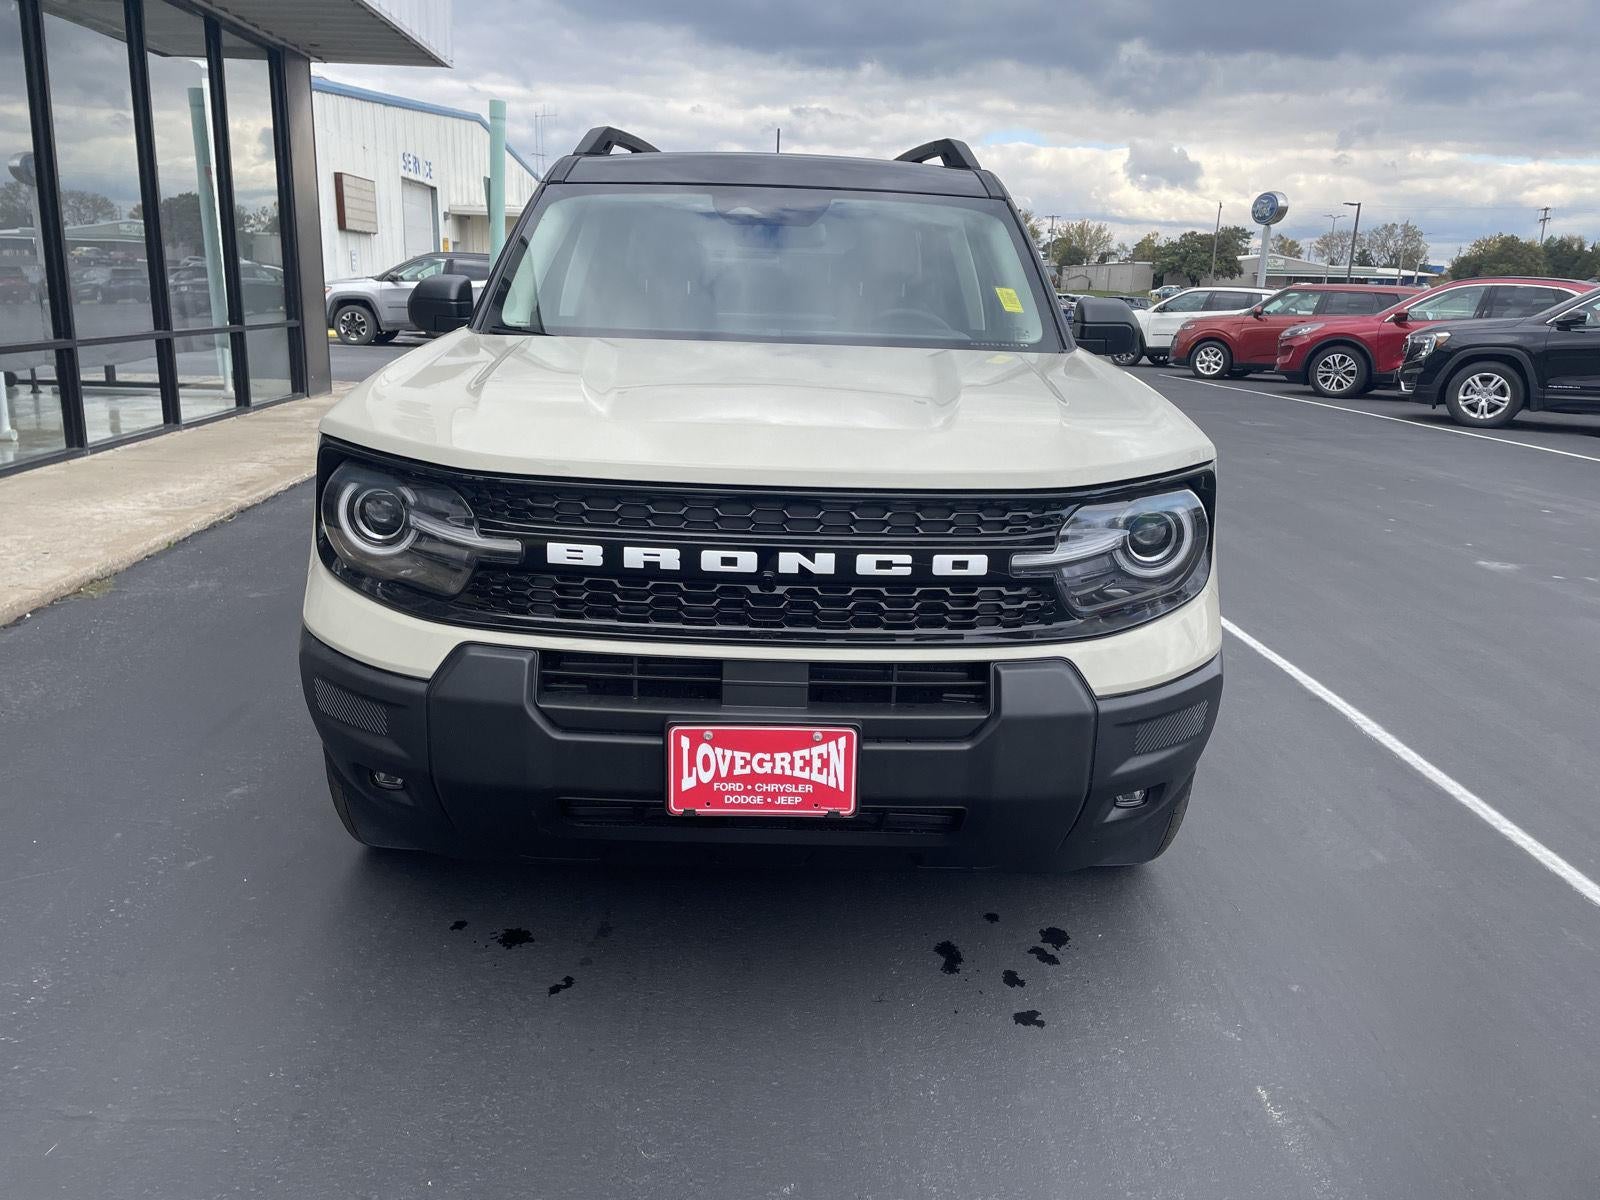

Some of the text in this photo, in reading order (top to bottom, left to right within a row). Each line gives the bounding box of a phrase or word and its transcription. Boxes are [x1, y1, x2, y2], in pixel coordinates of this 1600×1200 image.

[402, 152, 432, 179] SERVCE
[546, 542, 988, 576] BRONCO
[680, 735, 847, 792] LOVEGREEN
[713, 782, 813, 793] FORD CHRYSLER
[724, 795, 802, 805] DODGE JEEP
